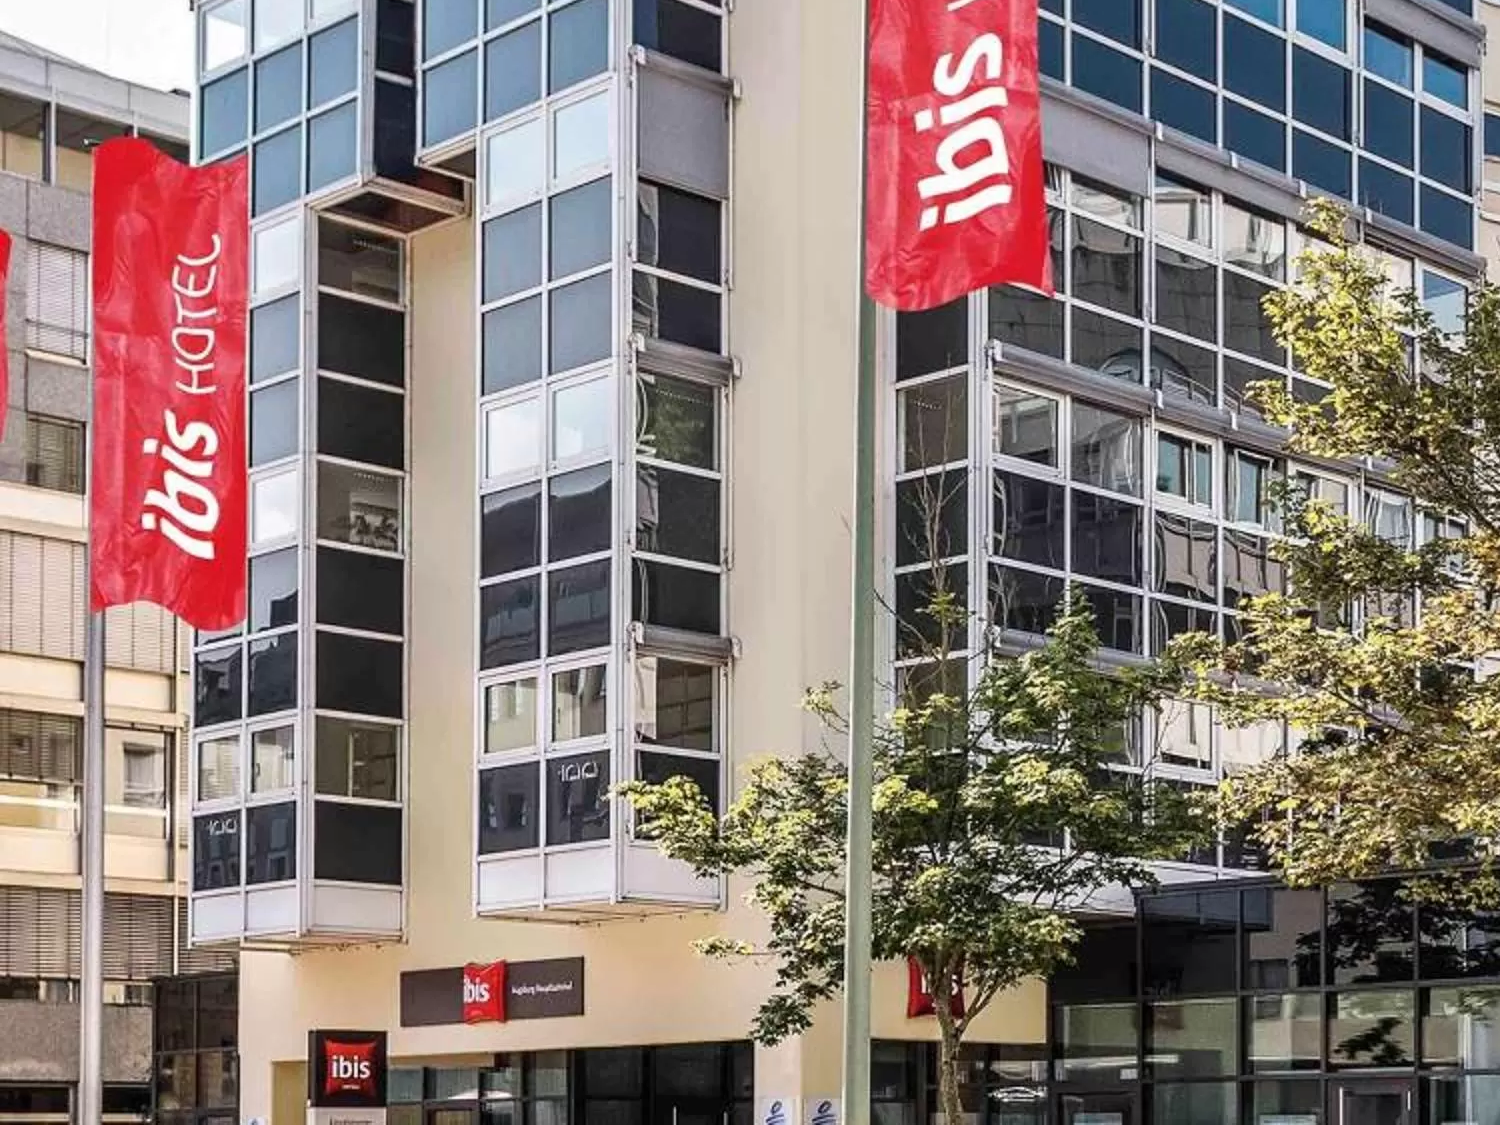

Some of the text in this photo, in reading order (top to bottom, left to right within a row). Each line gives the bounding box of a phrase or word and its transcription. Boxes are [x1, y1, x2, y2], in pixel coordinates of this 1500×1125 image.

[915, 33, 1012, 231] ibis
[142, 234, 222, 560] ibis HOTEL
[331, 1055, 371, 1079] ibis
